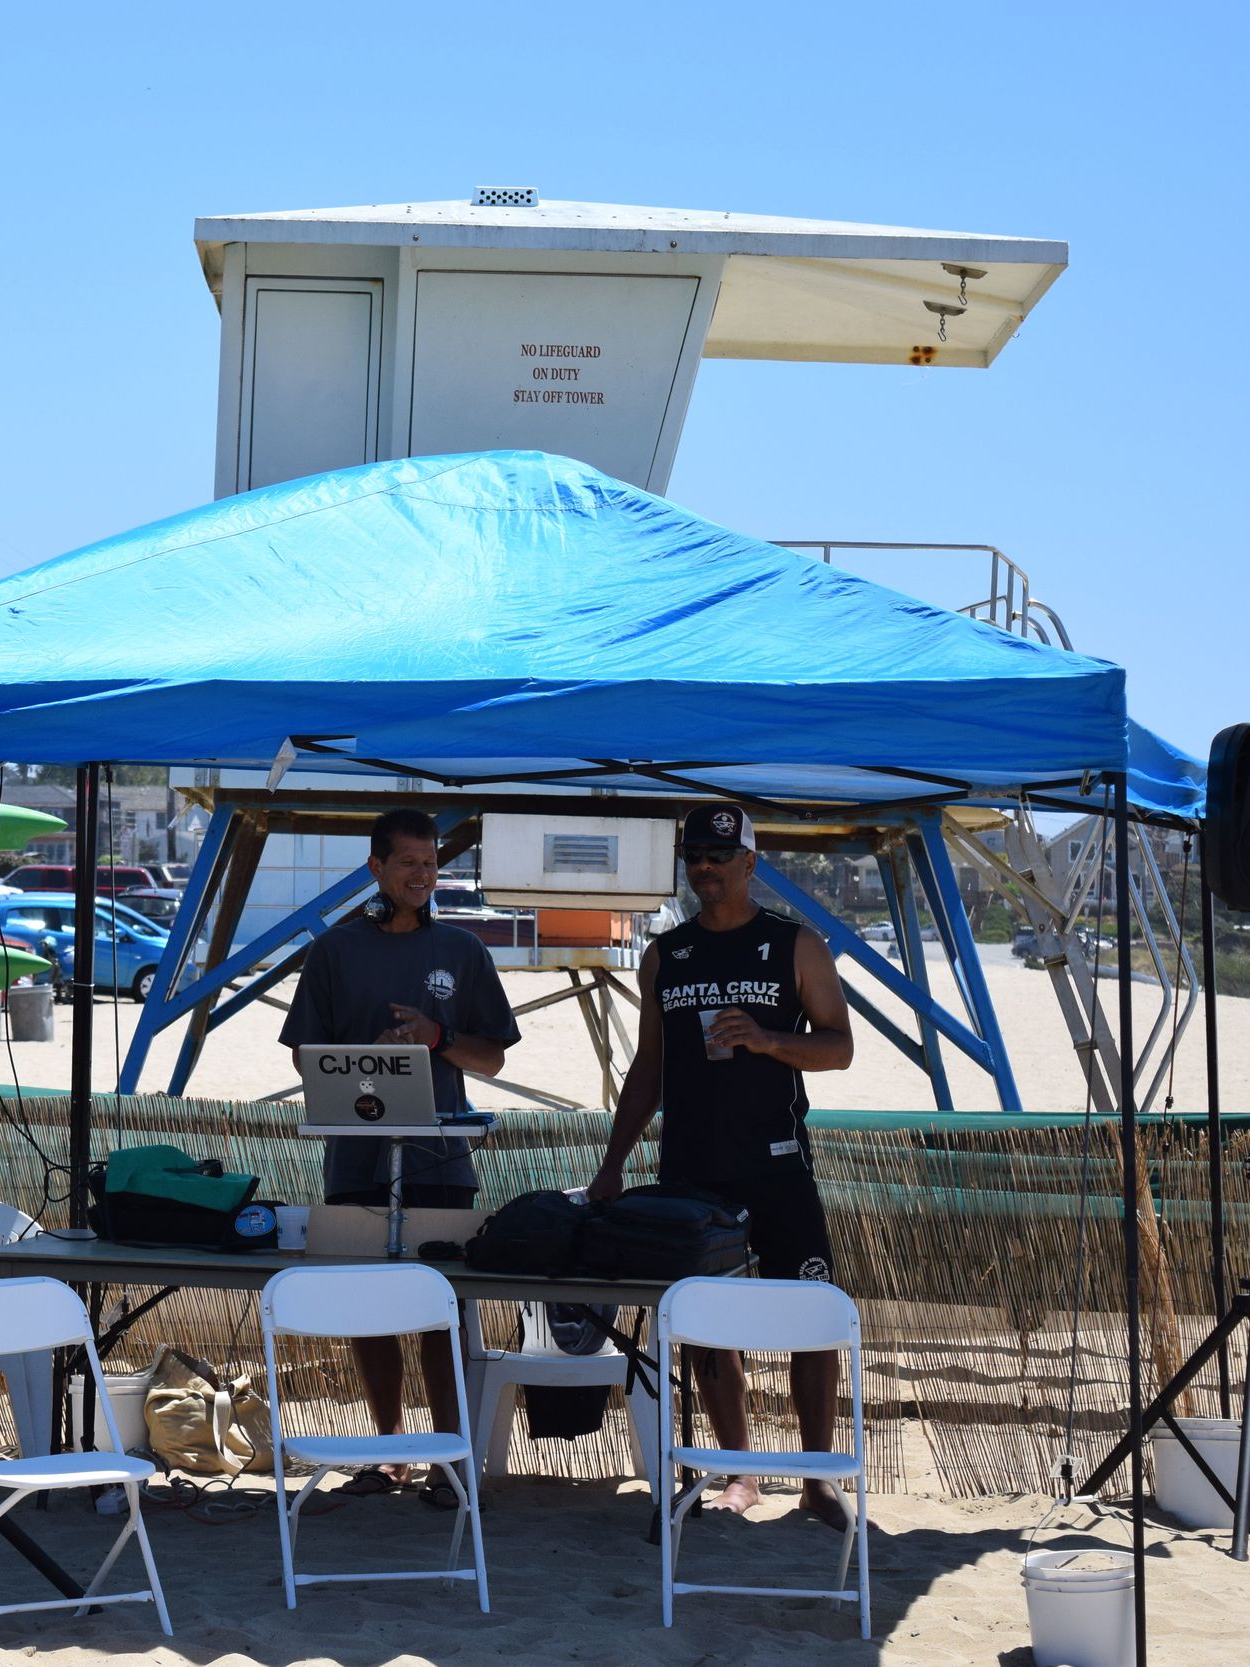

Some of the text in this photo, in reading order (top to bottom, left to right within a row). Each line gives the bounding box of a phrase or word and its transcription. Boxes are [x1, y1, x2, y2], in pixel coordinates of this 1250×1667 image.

[521, 344, 601, 358] NO LIFEGUARD
[532, 367, 580, 380] ON DUTY
[513, 390, 604, 404] STAY OFF TOWER
[757, 942, 770, 960] 1
[662, 981, 780, 1002] SANTA CRUZ
[663, 995, 778, 1012] BEACH VOLLEYBALL
